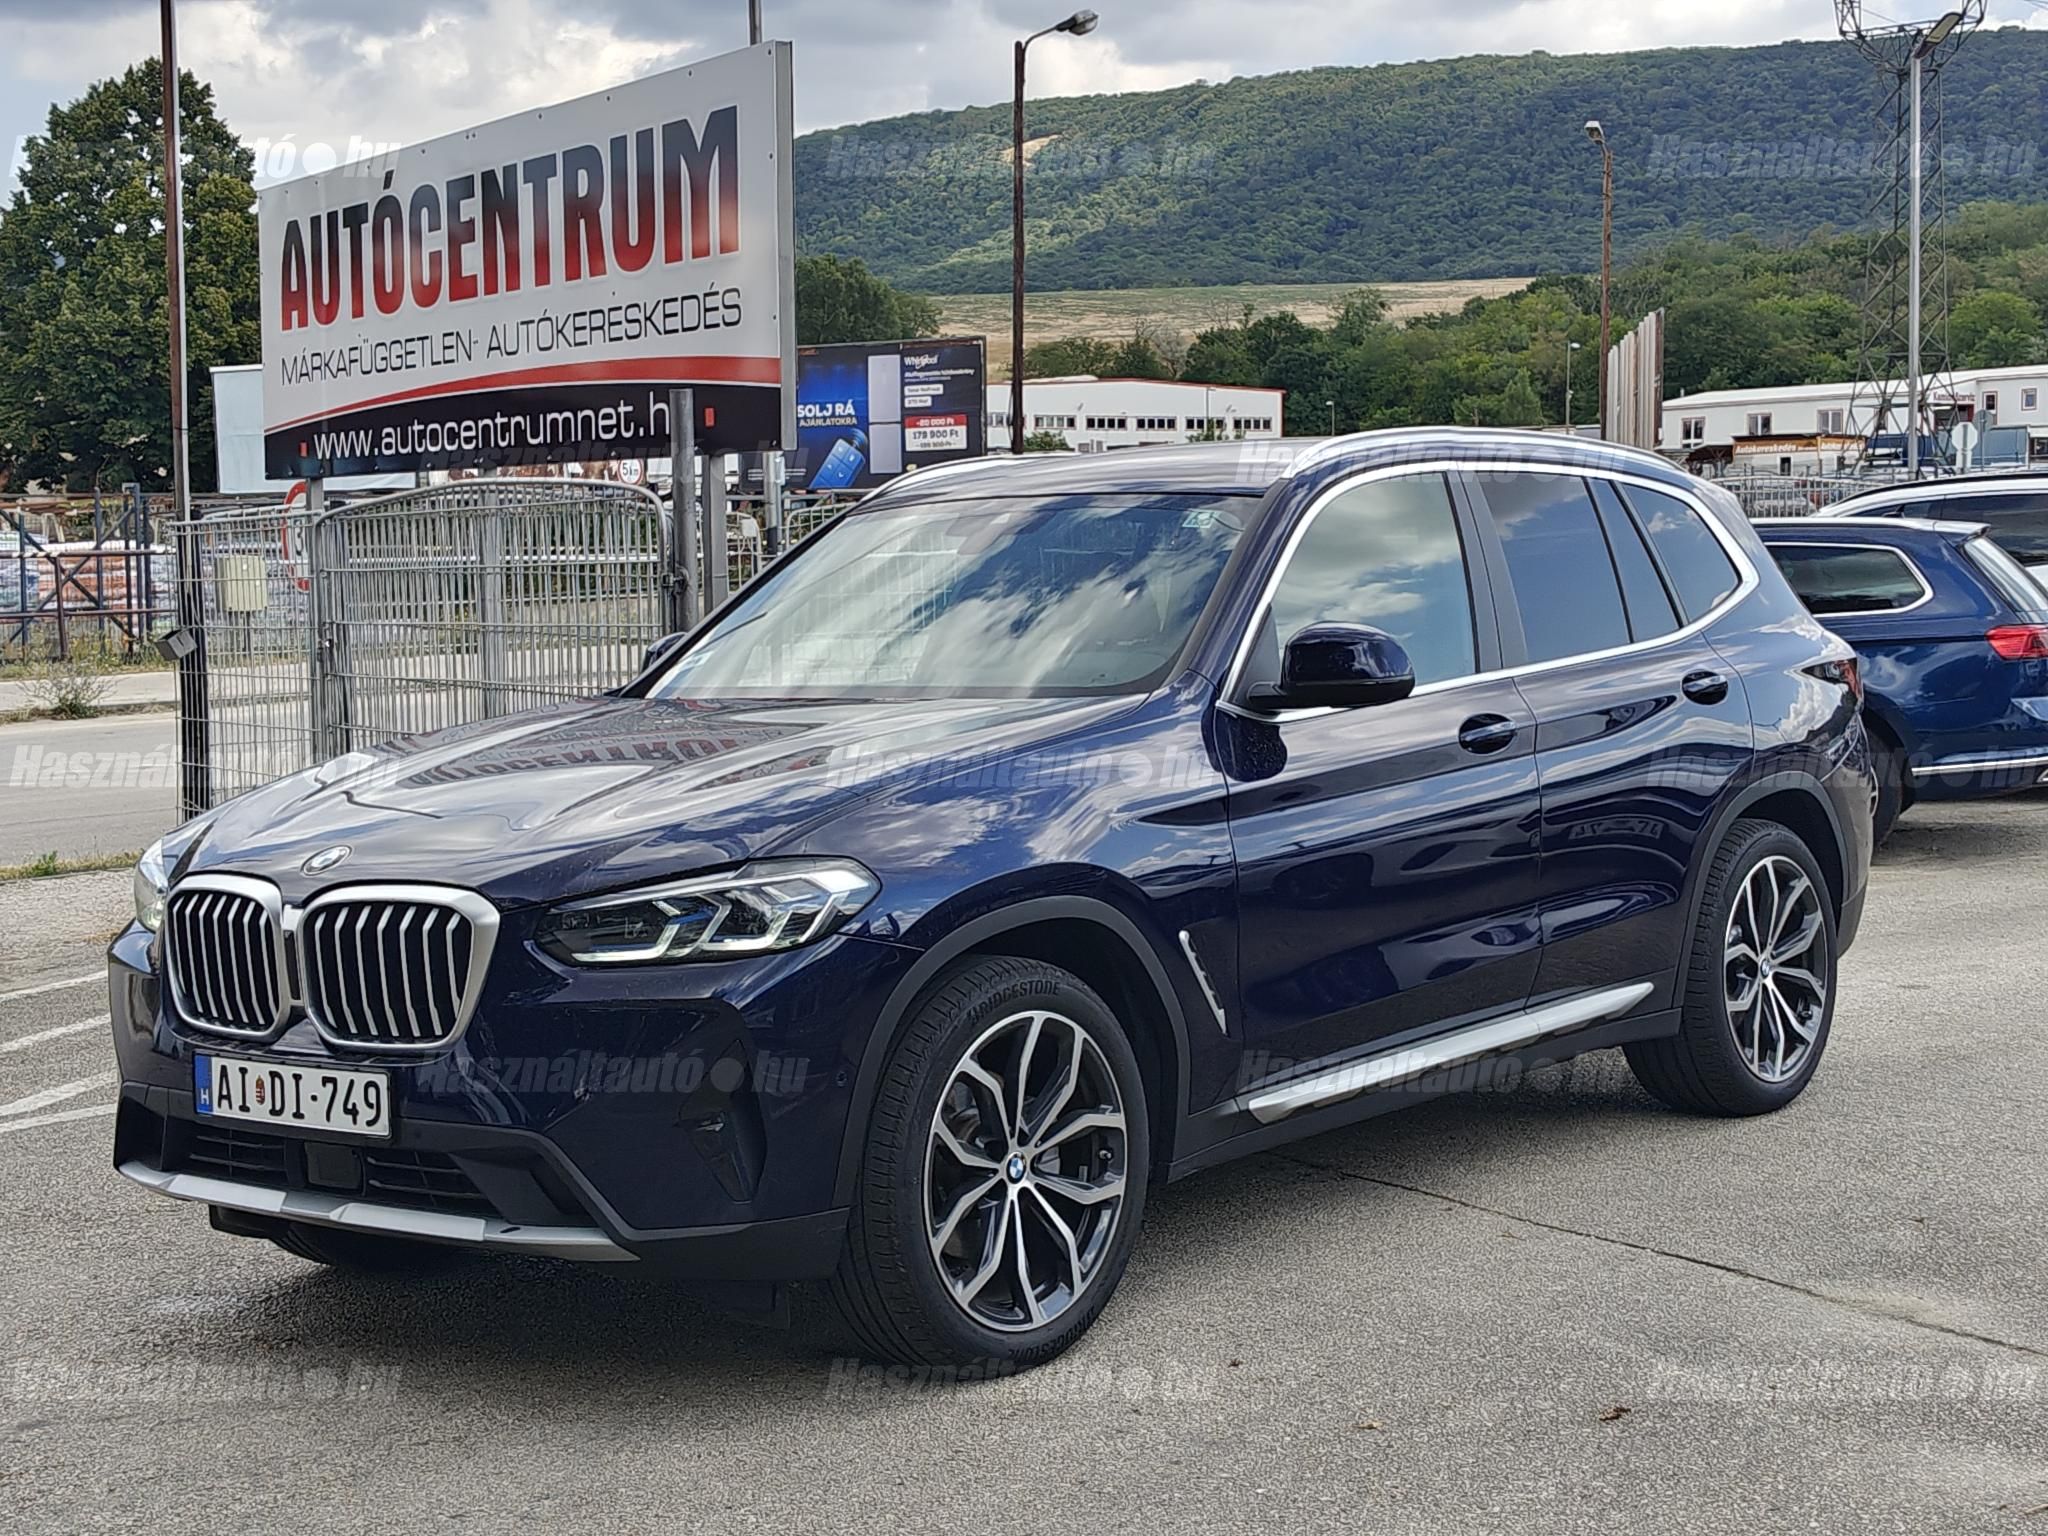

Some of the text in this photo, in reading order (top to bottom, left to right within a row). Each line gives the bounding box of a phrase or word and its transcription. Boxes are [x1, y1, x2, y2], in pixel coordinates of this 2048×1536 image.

[280, 103, 740, 332] AUTÓCENTRUM
[487, 281, 742, 357] AUTÓKERESKEDÉS
[313, 391, 671, 460] www.autocentrumnet.h
[834, 399, 856, 416] RÁ
[949, 428, 959, 438] Ft
[966, 979, 1061, 1026] BRIDGESTONE
[200, 1087, 209, 1105] H
[217, 1064, 382, 1127] AI DI-749
